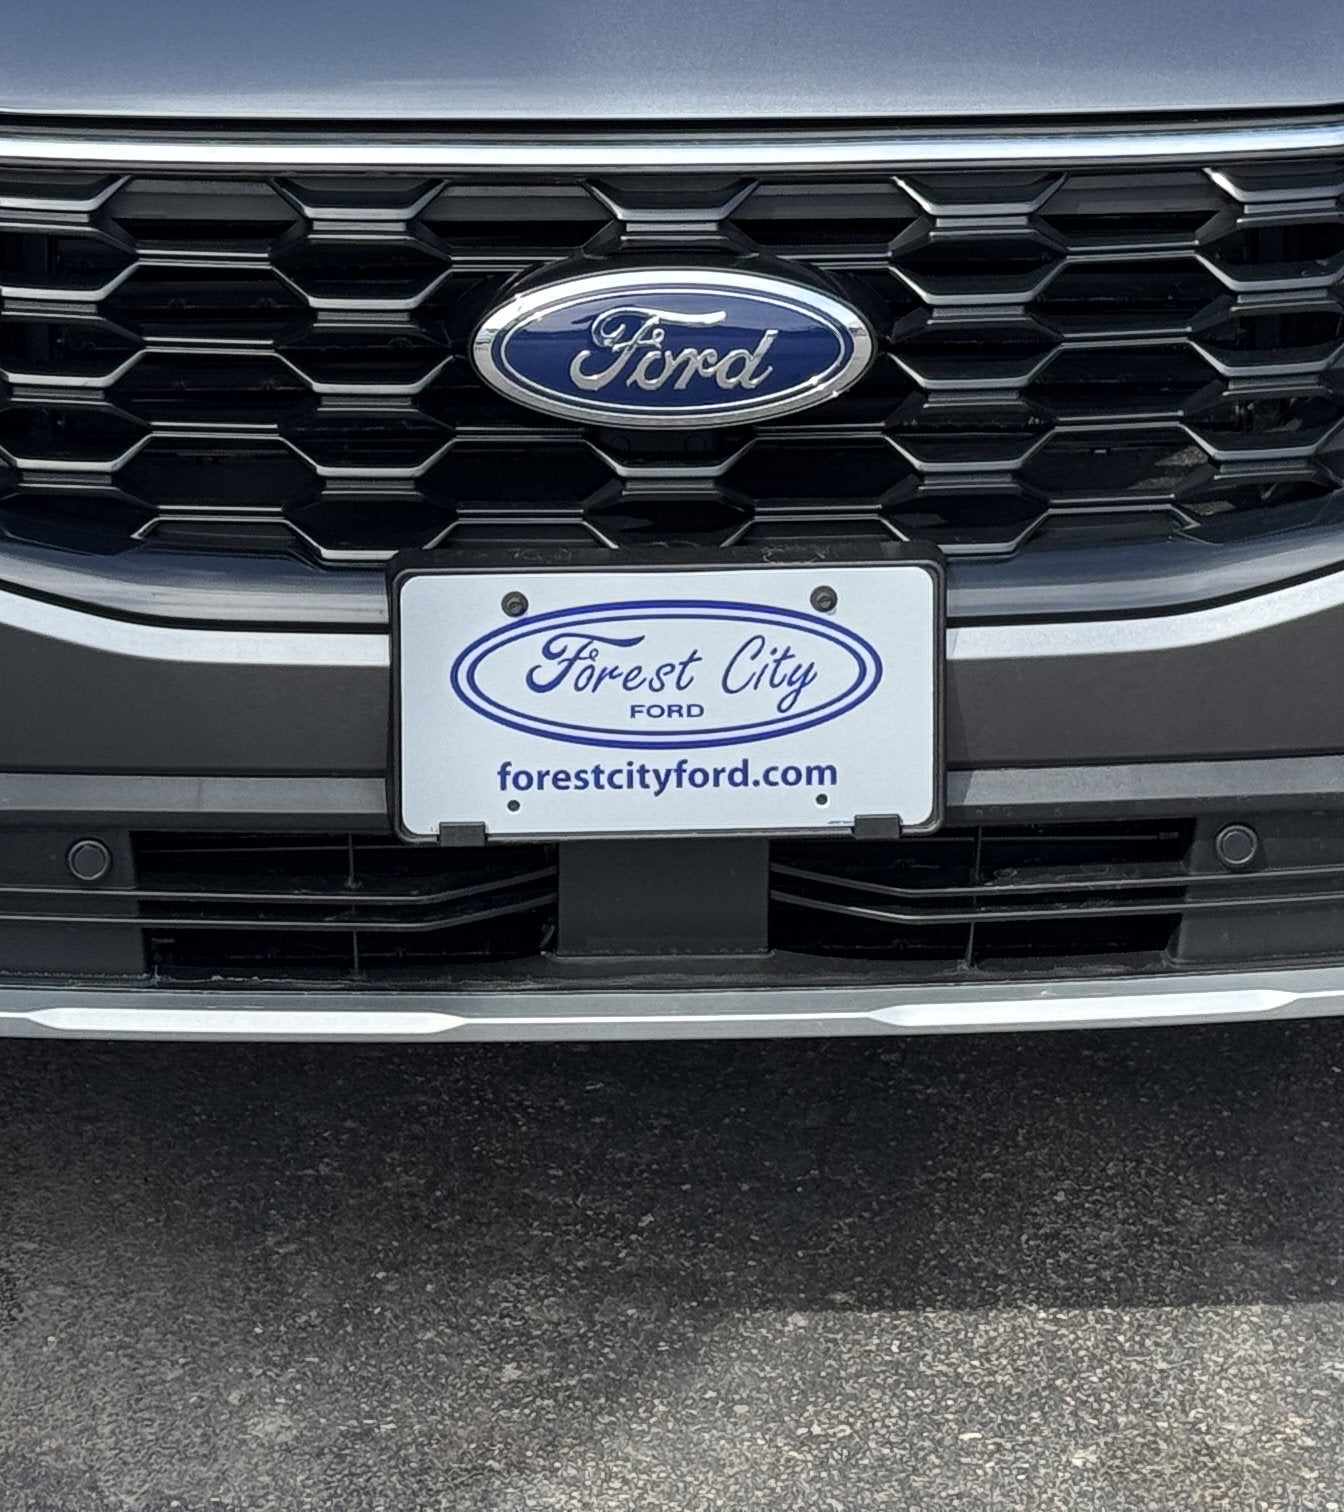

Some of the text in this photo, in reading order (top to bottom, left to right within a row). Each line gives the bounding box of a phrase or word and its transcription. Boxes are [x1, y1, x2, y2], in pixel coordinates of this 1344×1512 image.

[569, 305, 779, 391] Ford
[525, 631, 819, 715] Forest City
[628, 702, 705, 720] FORD
[496, 757, 839, 797] forestcityford.com
